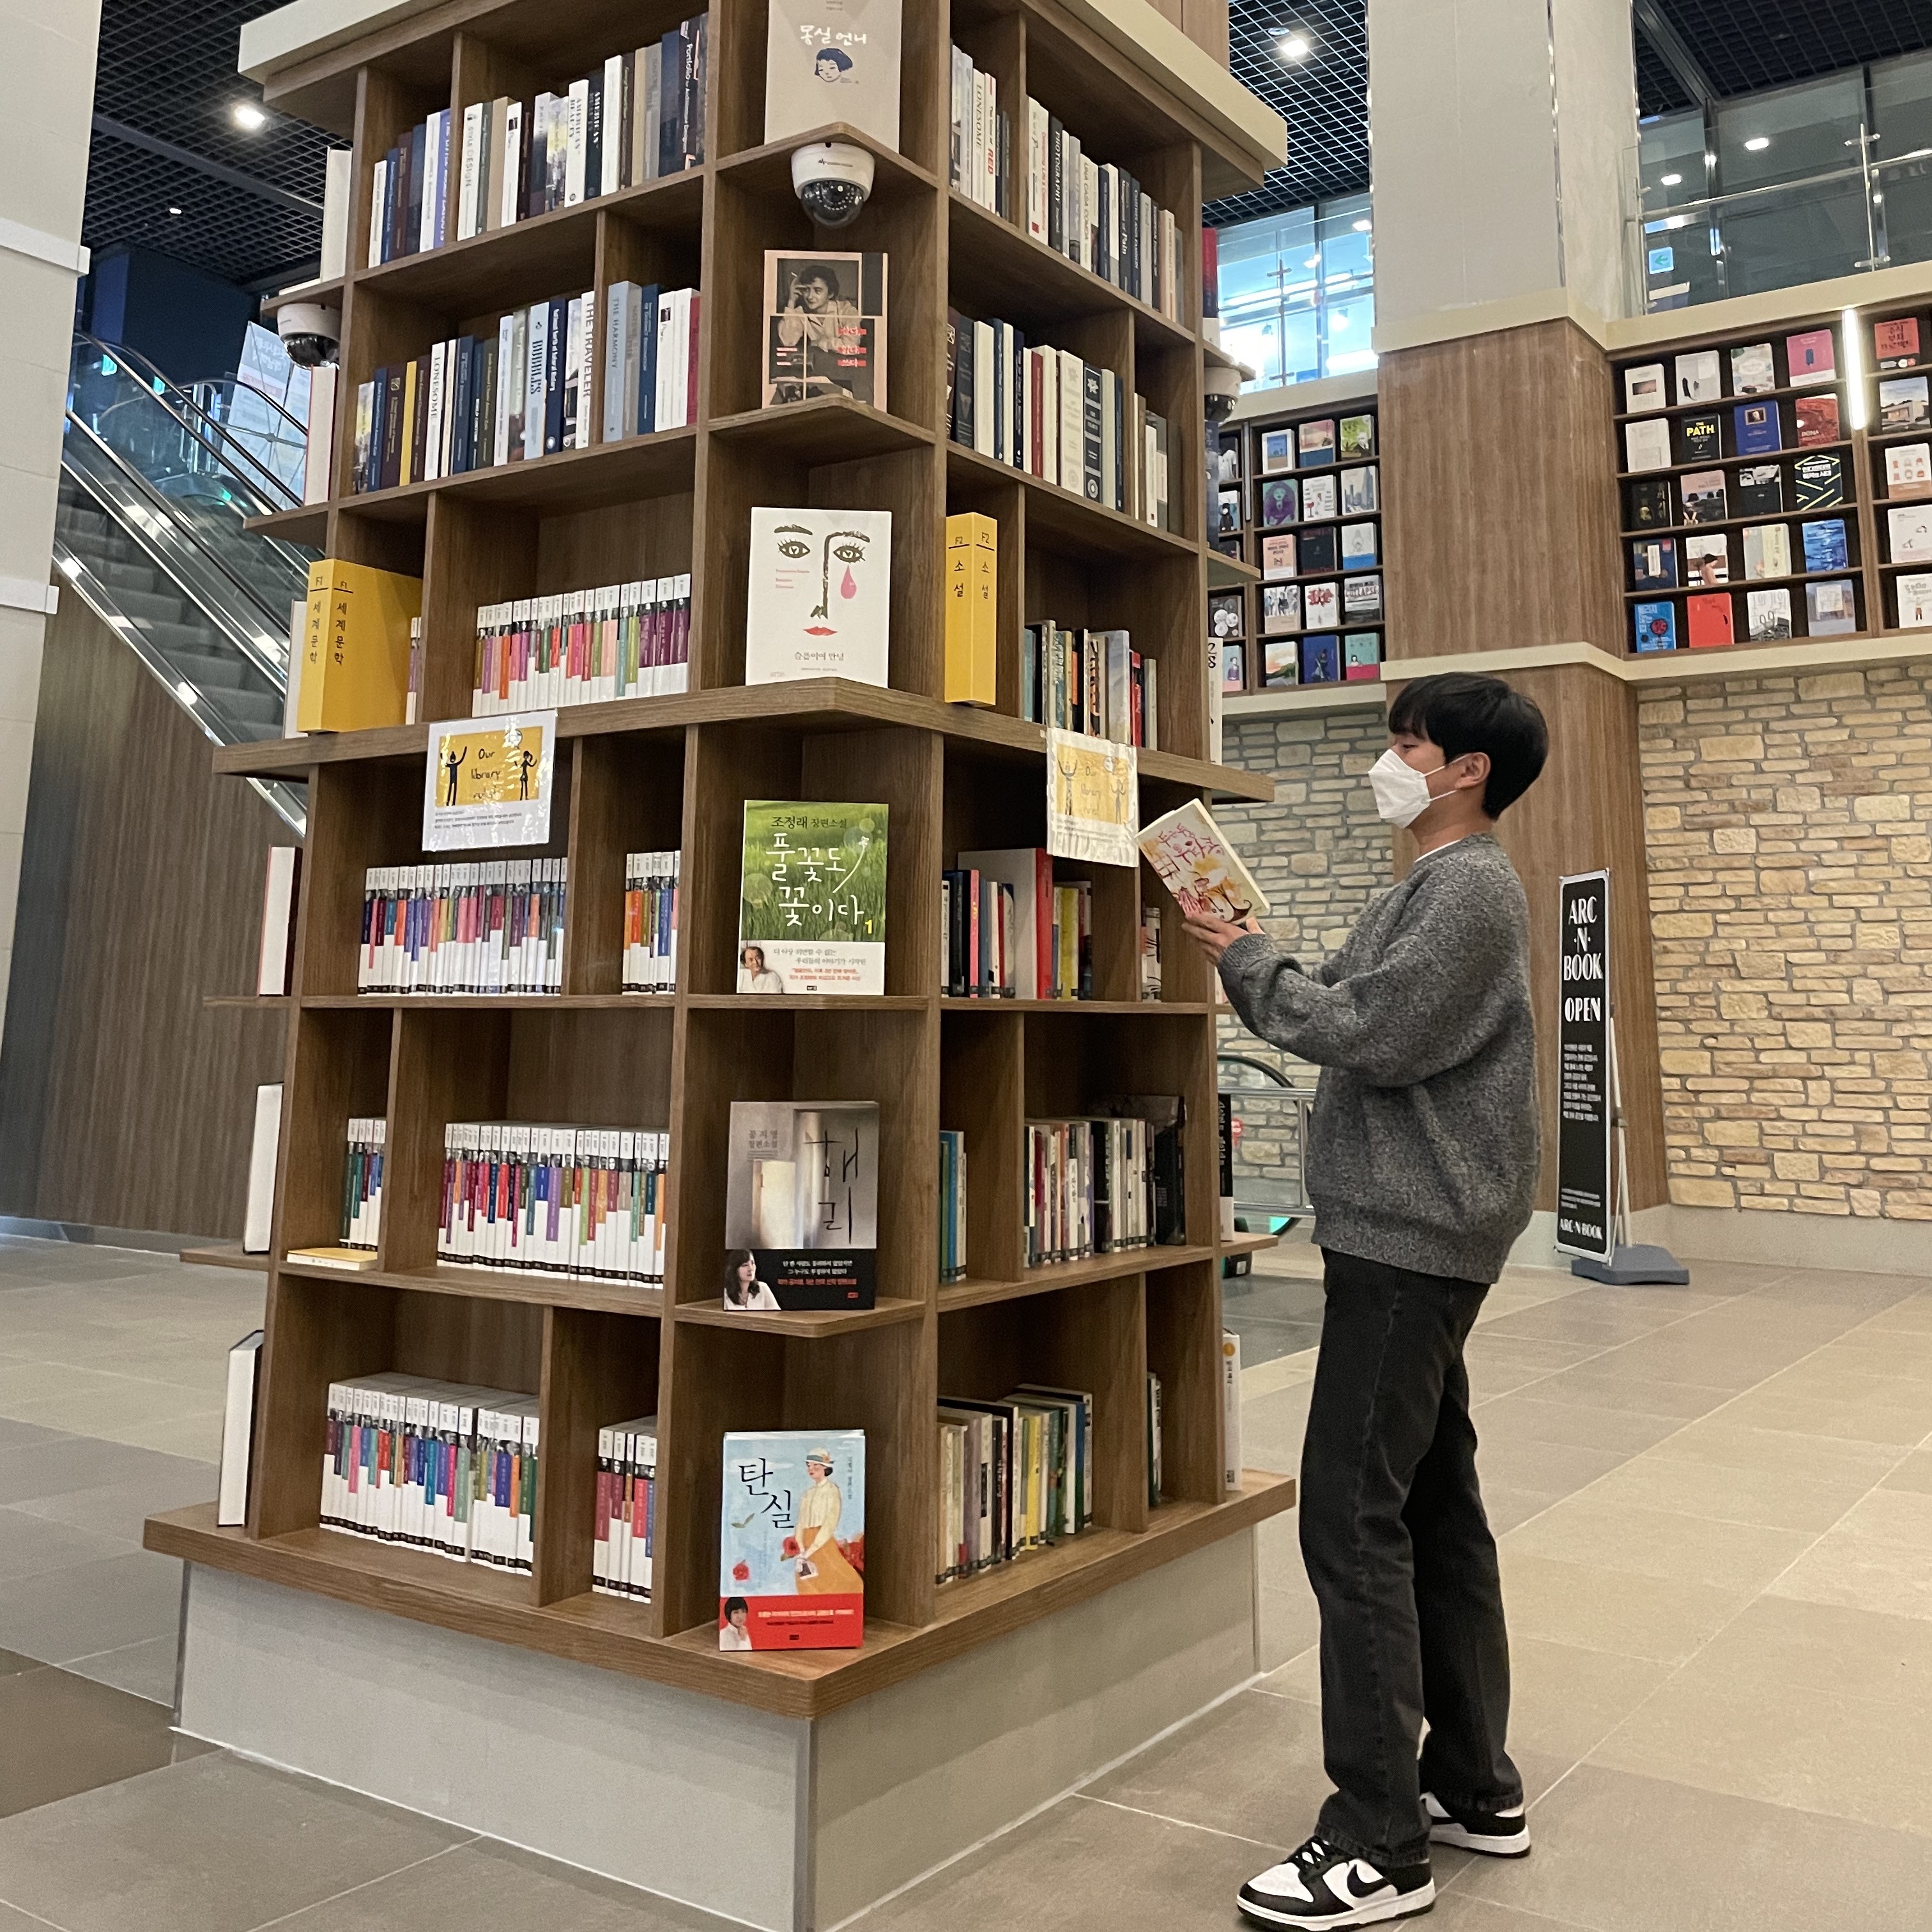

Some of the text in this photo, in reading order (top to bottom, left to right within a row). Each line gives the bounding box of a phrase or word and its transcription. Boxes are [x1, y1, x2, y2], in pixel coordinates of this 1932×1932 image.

[799, 24, 867, 46] 몽실 언니
[583, 302, 594, 398] THE TRAVELER
[610, 319, 620, 369] HARMONY
[530, 340, 544, 395] BUBBLES
[429, 356, 441, 420] LONESOME
[1686, 424, 1715, 437] PATH
[954, 536, 963, 544] F2
[981, 532, 990, 544] F2
[828, 652, 845, 661] 안녕
[478, 748, 495, 760] Our
[770, 815, 847, 829] 조정래 장편소설
[765, 832, 847, 882] 풀꽃도
[778, 886, 873, 934] 꽃이다 1
[1568, 896, 1598, 926] ARC
[1563, 953, 1604, 981] BOOK
[1564, 997, 1601, 1022] OPEN
[737, 1457, 795, 1529] 탄실
